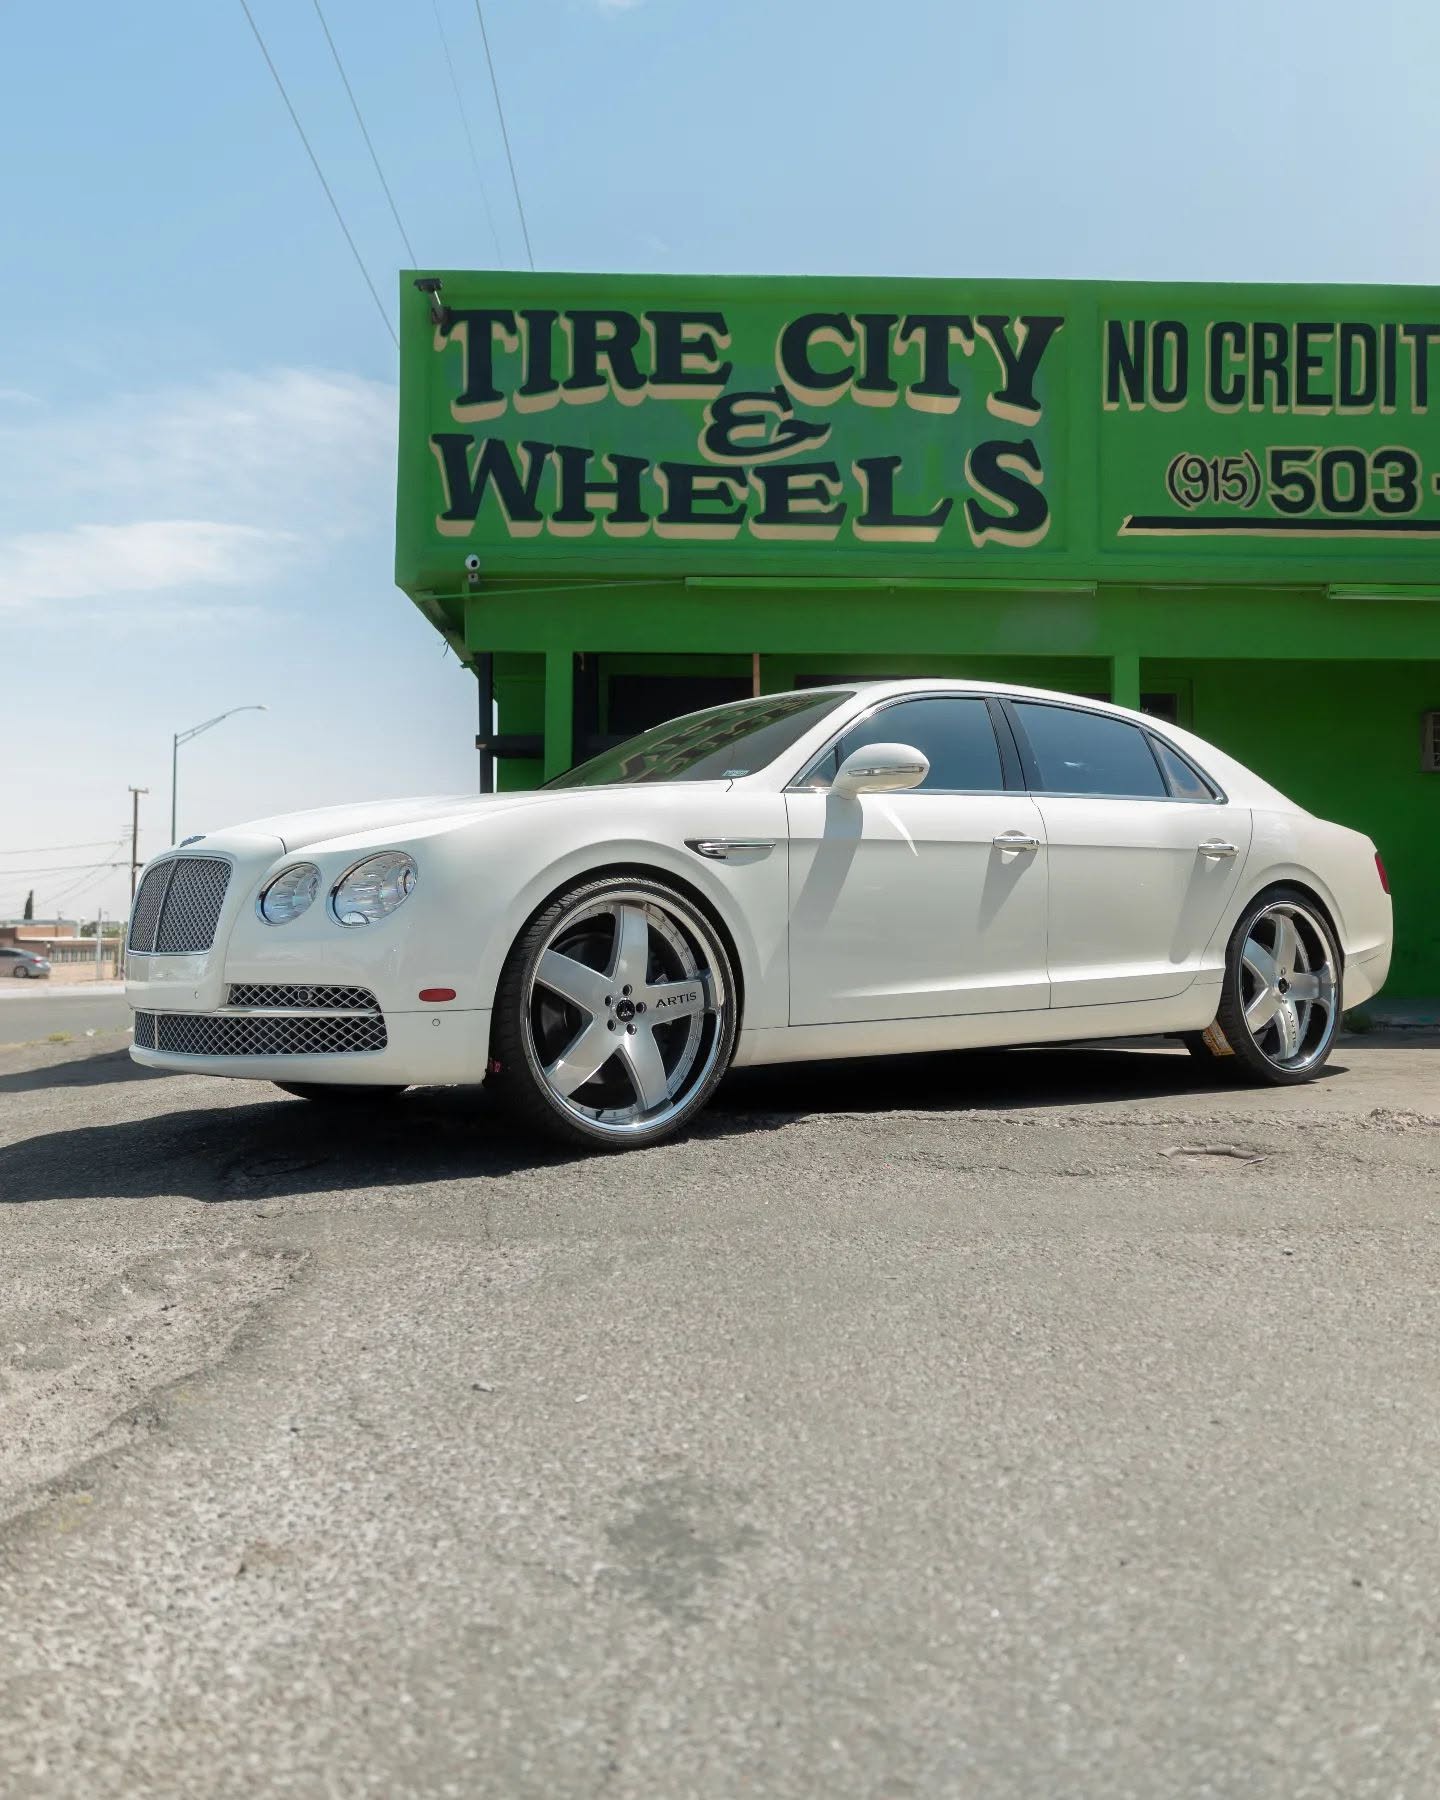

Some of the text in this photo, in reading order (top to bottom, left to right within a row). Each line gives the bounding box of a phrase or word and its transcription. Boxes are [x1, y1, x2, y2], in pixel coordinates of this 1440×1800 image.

[433, 309, 1065, 426] TIRE CITY
[1102, 319, 1440, 416] NO CREDIT
[698, 385, 831, 466] &
[430, 432, 1051, 547] WHEELS
[655, 991, 697, 1009] ARTIS
